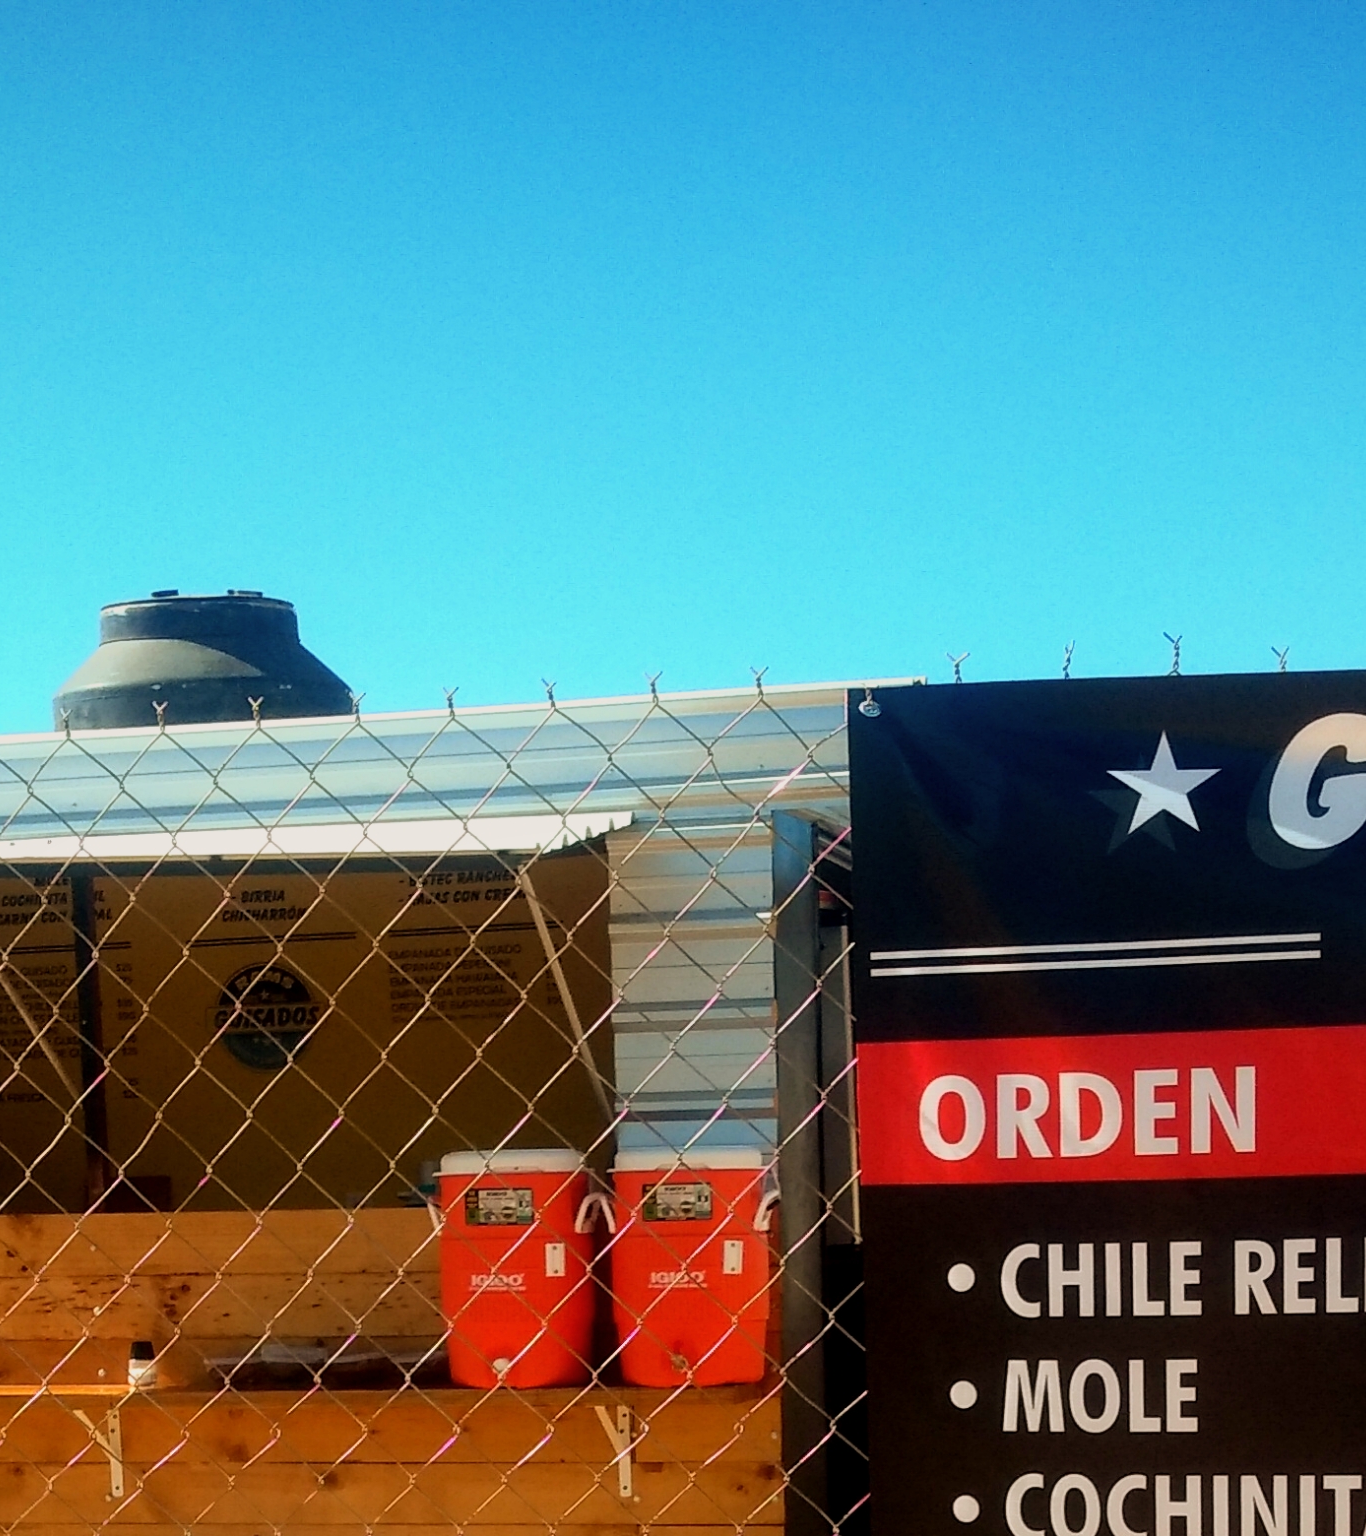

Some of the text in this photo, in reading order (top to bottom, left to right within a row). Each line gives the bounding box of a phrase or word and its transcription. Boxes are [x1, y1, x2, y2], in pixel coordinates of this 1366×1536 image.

[919, 1066, 1255, 1160] ORDEN
[1001, 1242, 1202, 1317] CHILE
[1003, 1359, 1197, 1433] MOLE
